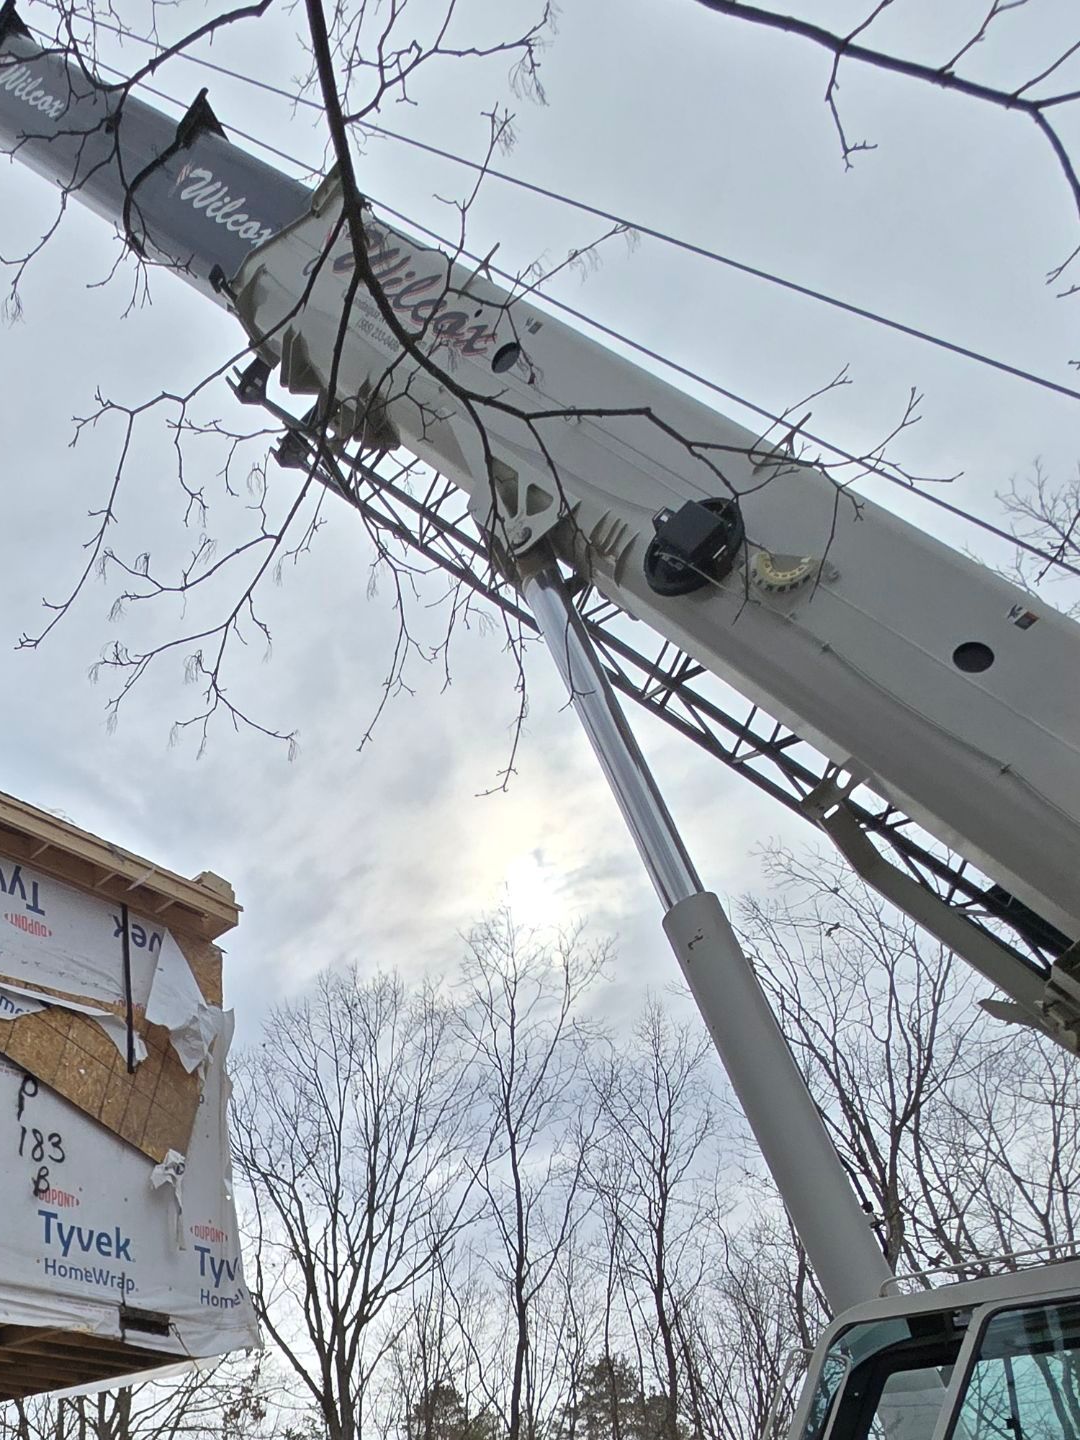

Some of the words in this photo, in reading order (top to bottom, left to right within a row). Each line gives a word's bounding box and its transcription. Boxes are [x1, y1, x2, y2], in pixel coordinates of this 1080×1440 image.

[181, 168, 273, 247] Wilcox
[332, 226, 497, 357] Wilcox
[10, 913, 47, 938] DUPONT
[19, 1126, 65, 1163] 183
[31, 1166, 50, 1197] B
[38, 1209, 131, 1262] Tyvek
[194, 1226, 224, 1243] DUPONT
[45, 1257, 135, 1294] HomeWrap
[194, 1245, 239, 1288] Tyv
